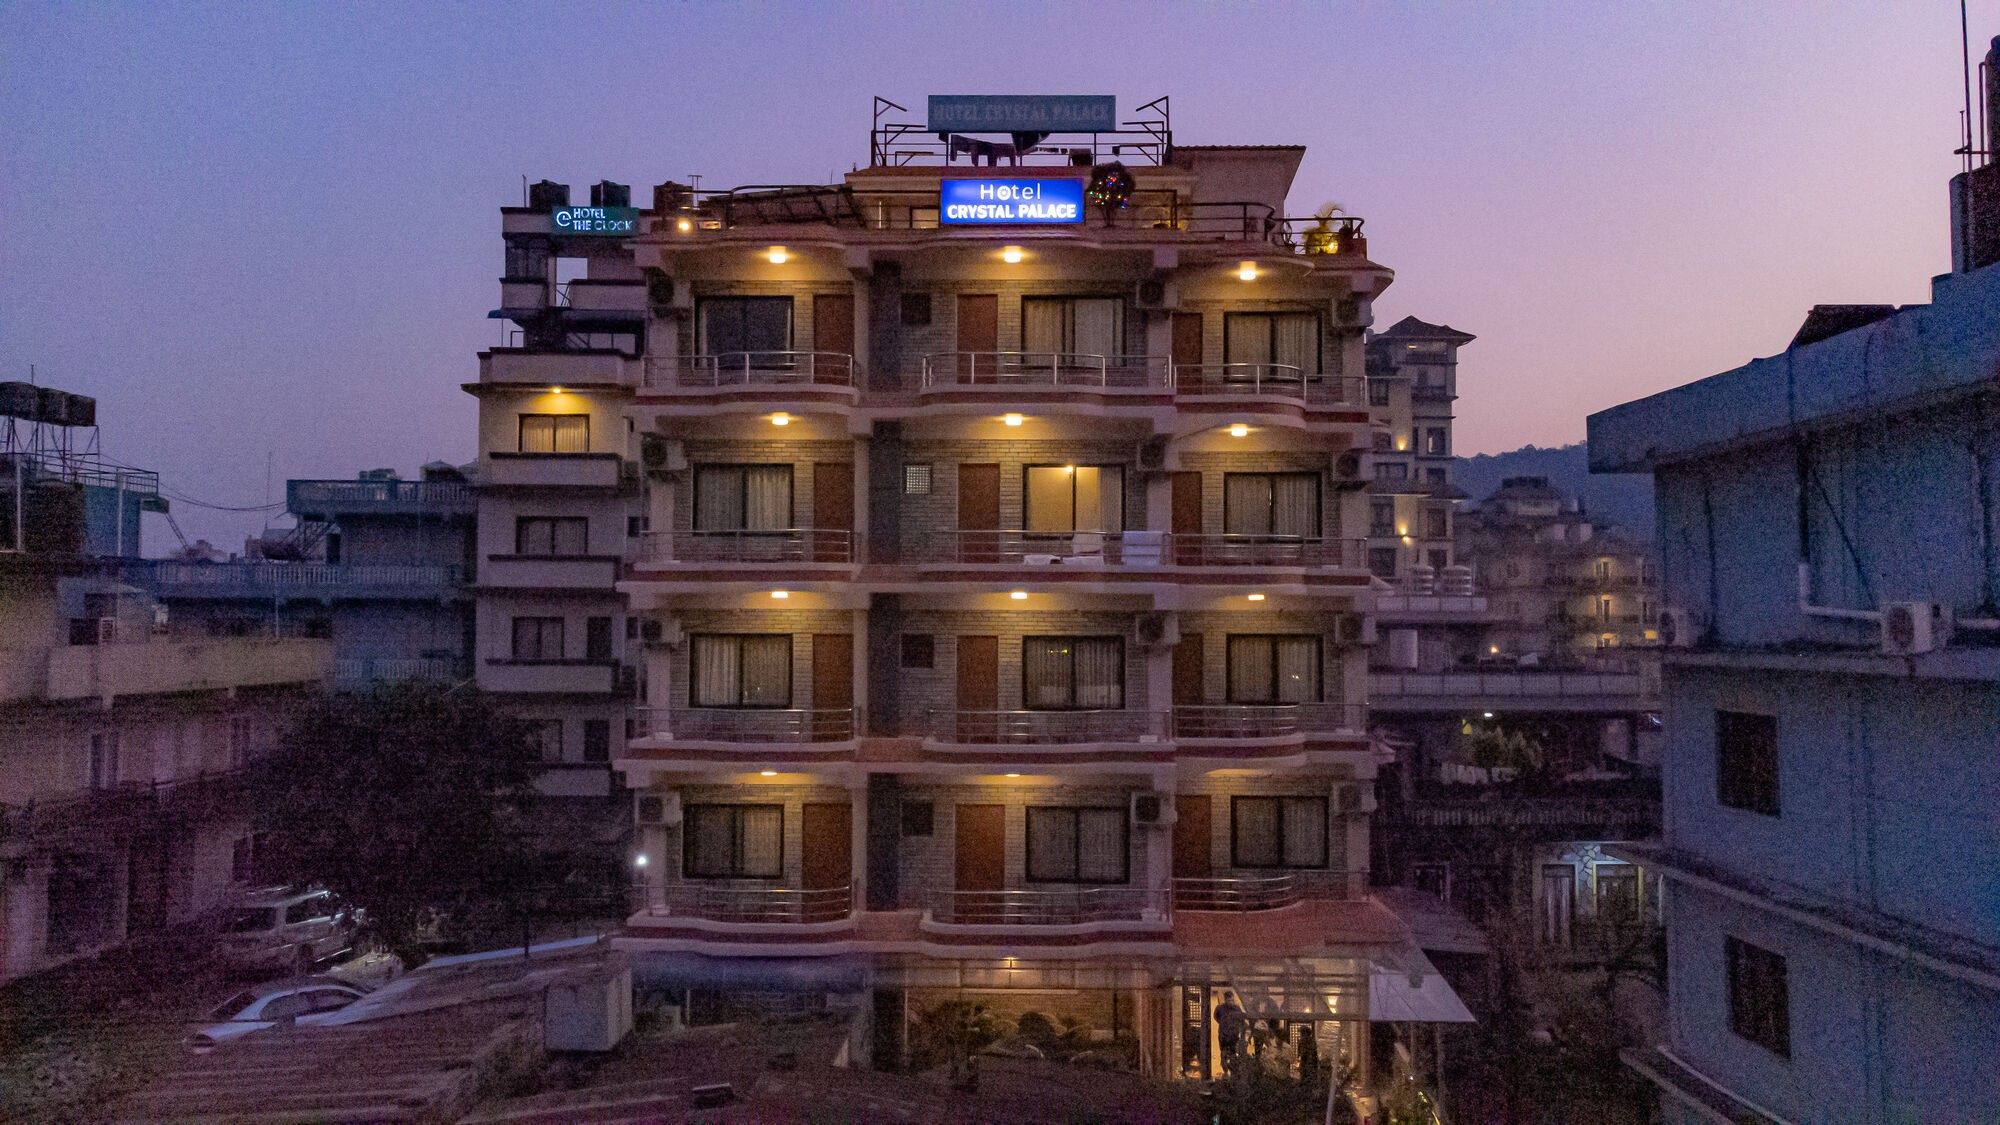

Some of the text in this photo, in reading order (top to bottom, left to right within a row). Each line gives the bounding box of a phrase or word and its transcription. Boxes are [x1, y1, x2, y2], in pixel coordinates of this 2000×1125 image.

[934, 104, 1108, 121] HOTEL CRYSTAL PALACE
[980, 183, 1041, 200] Hotel
[573, 208, 606, 219] HOTEL
[947, 204, 1076, 218] CRYSTAL PALACE
[573, 220, 633, 231] THE CLOCK
